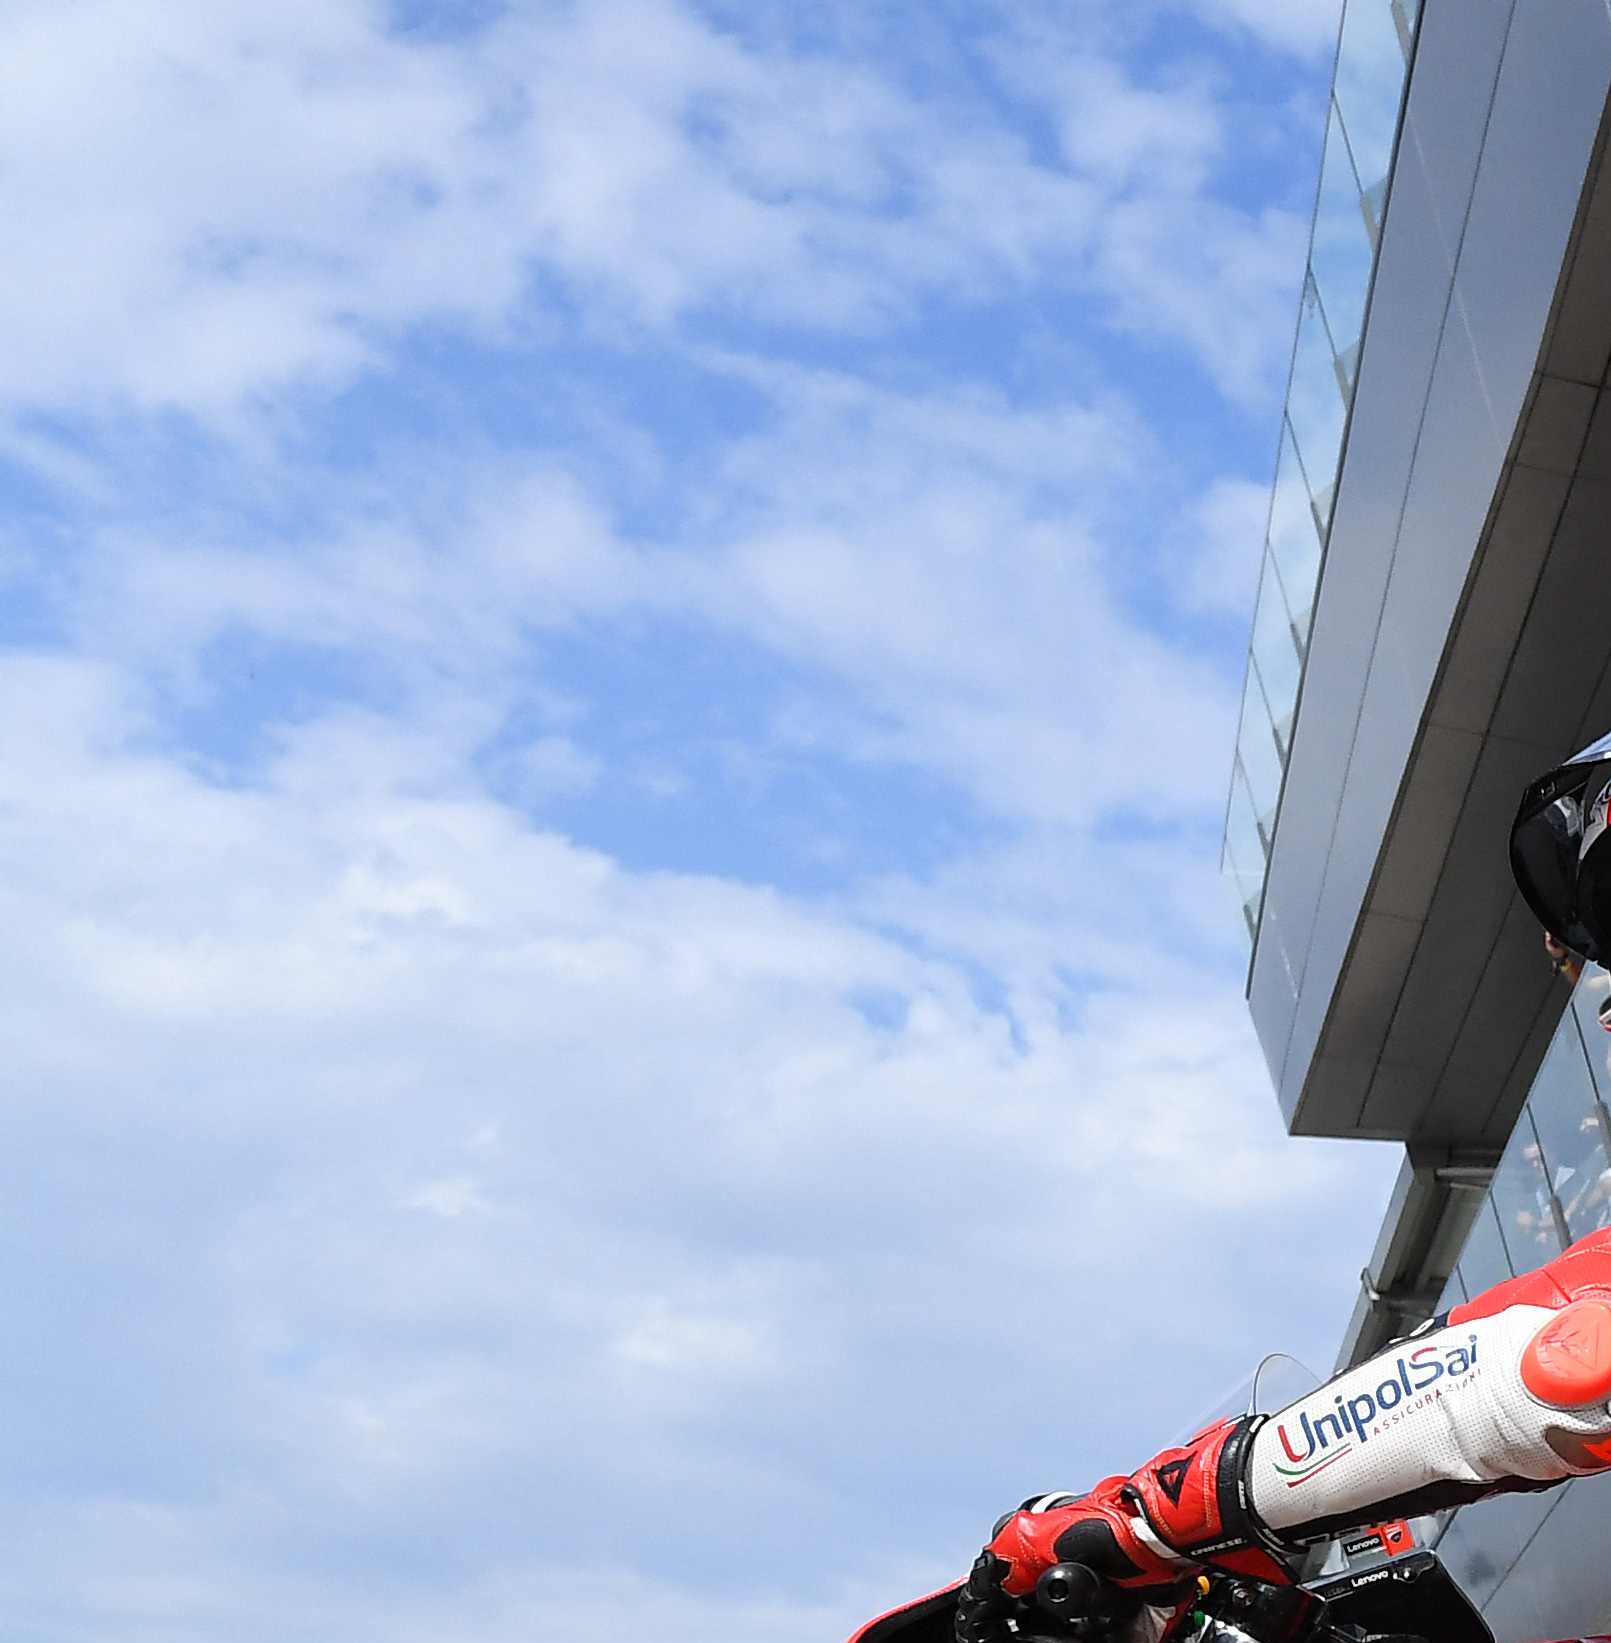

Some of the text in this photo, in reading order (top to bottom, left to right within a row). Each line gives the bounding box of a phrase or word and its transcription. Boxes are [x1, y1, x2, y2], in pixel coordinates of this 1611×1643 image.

[1276, 1335, 1479, 1463] UnipolSai
[1346, 1536, 1380, 1554] Lenovo
[1351, 1570, 1389, 1588] Lenovo
